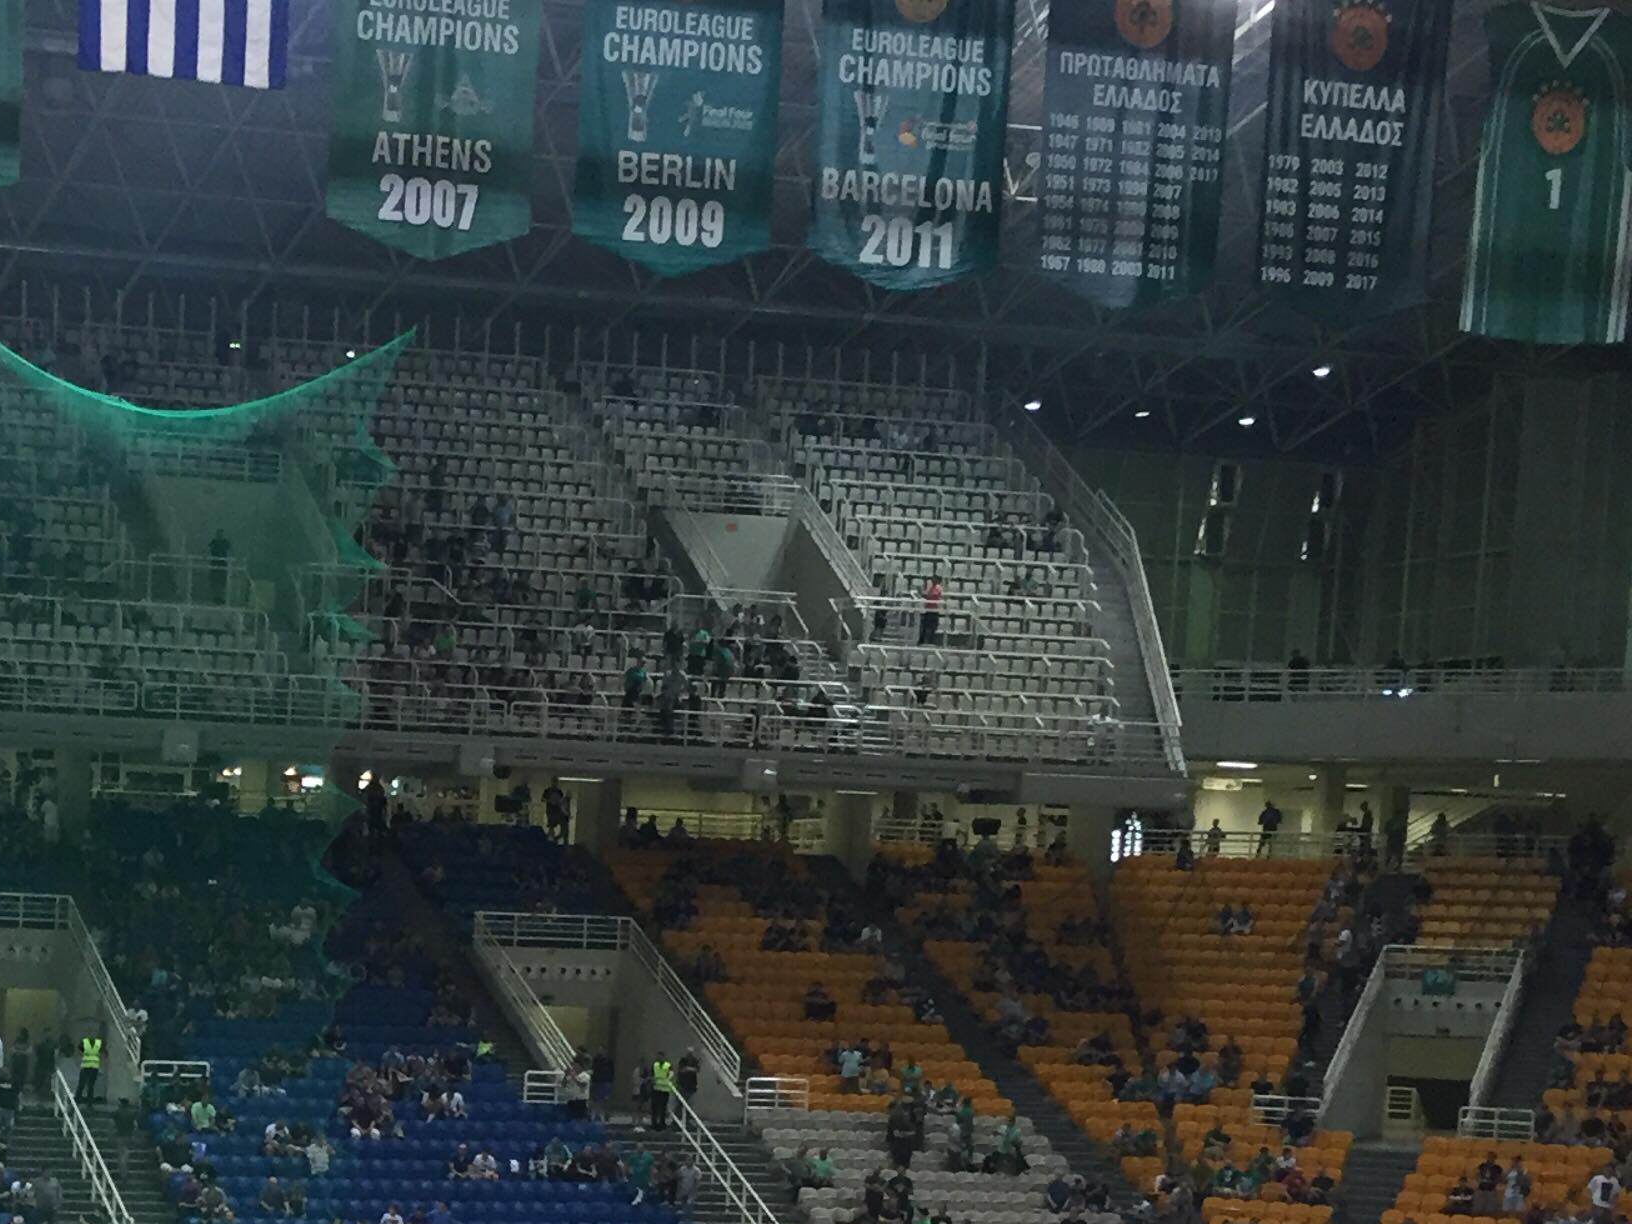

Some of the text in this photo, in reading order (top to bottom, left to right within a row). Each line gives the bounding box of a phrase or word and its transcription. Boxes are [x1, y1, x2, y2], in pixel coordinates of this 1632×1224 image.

[357, 10, 520, 55] CHAMPIONS
[616, 6, 754, 41] EUROLEAGUE
[603, 32, 763, 75] CHAMPIONS
[852, 28, 984, 63] EUROLEAGUE
[839, 54, 992, 97] CHAMPIONS
[1060, 52, 1220, 88] ΠΡΩΤΑΘΛΗΜΑΤΑ
[1093, 84, 1183, 114] ΕΛΛΑΔΟΣ
[1304, 79, 1406, 113] ΚΥΠΕΛΛΑ
[1300, 113, 1404, 147] ΕΛΛΑΔΟΣ
[372, 131, 493, 173] ATHENS
[617, 150, 737, 191] BERLIN
[378, 174, 479, 231] 2007
[822, 167, 993, 213] BARCELONA
[1545, 168, 1562, 210] 1
[621, 194, 724, 248] 2009
[1351, 207, 1384, 224] 2014
[859, 214, 953, 269] 2011
[1345, 273, 1378, 290] 2017
